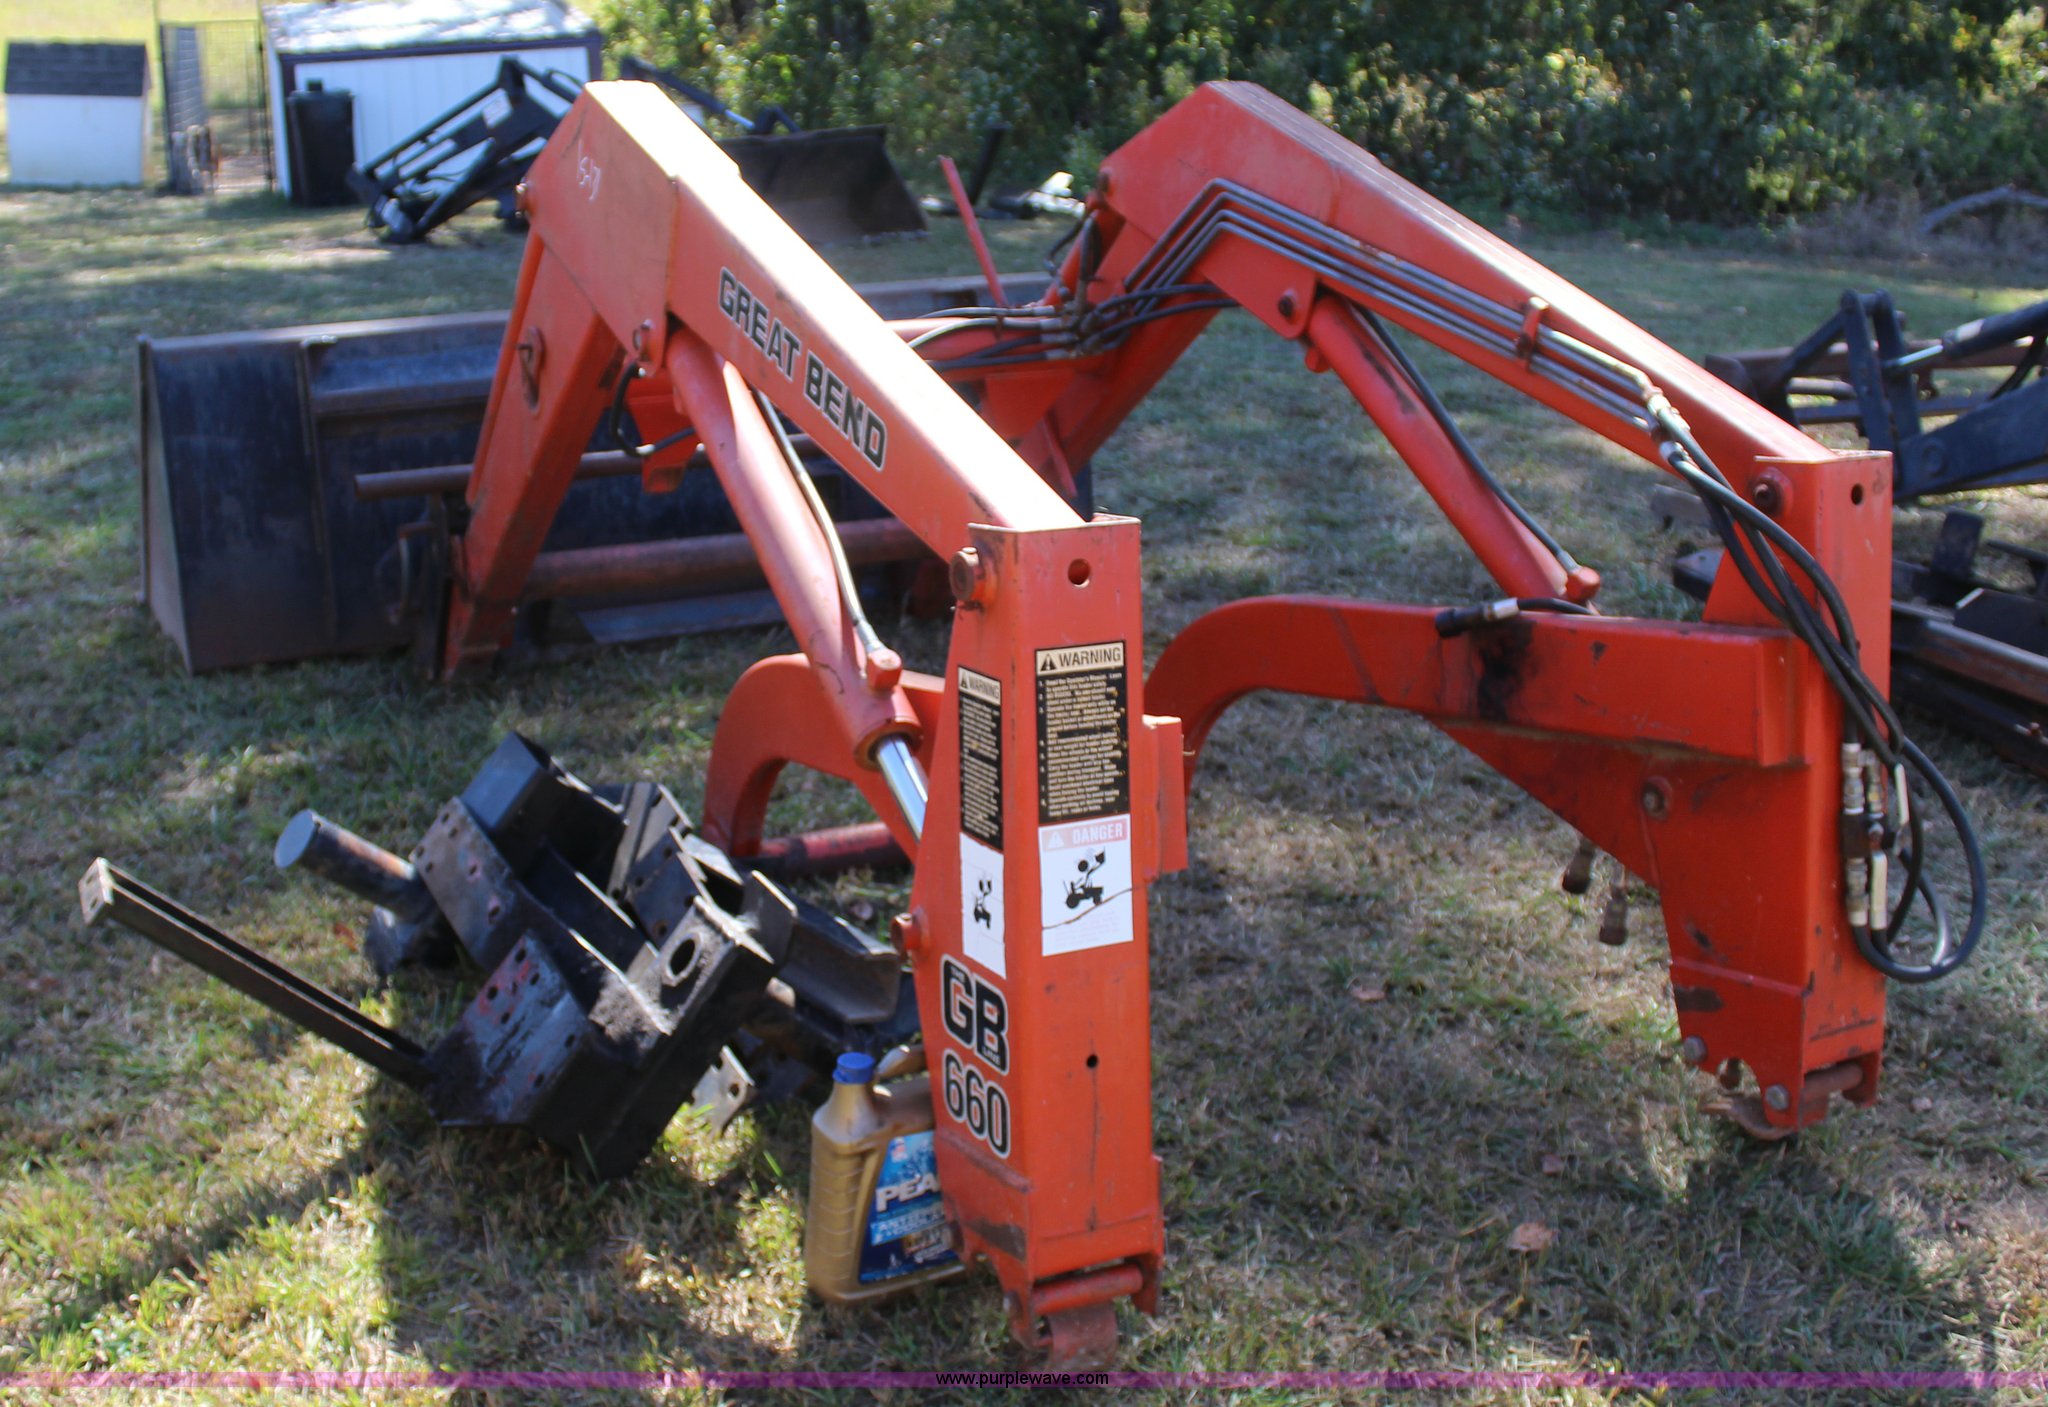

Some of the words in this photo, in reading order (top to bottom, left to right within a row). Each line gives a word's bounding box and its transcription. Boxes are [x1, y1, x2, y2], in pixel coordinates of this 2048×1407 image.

[718, 266, 802, 382] GREAT
[803, 349, 888, 473] BEND
[1058, 646, 1122, 669] WARNING
[967, 675, 1001, 700] WARNING
[1072, 823, 1124, 846] DANGER
[940, 953, 1009, 1076] GB
[942, 1048, 1012, 1159] 660
[876, 1172, 942, 1212] PEA
